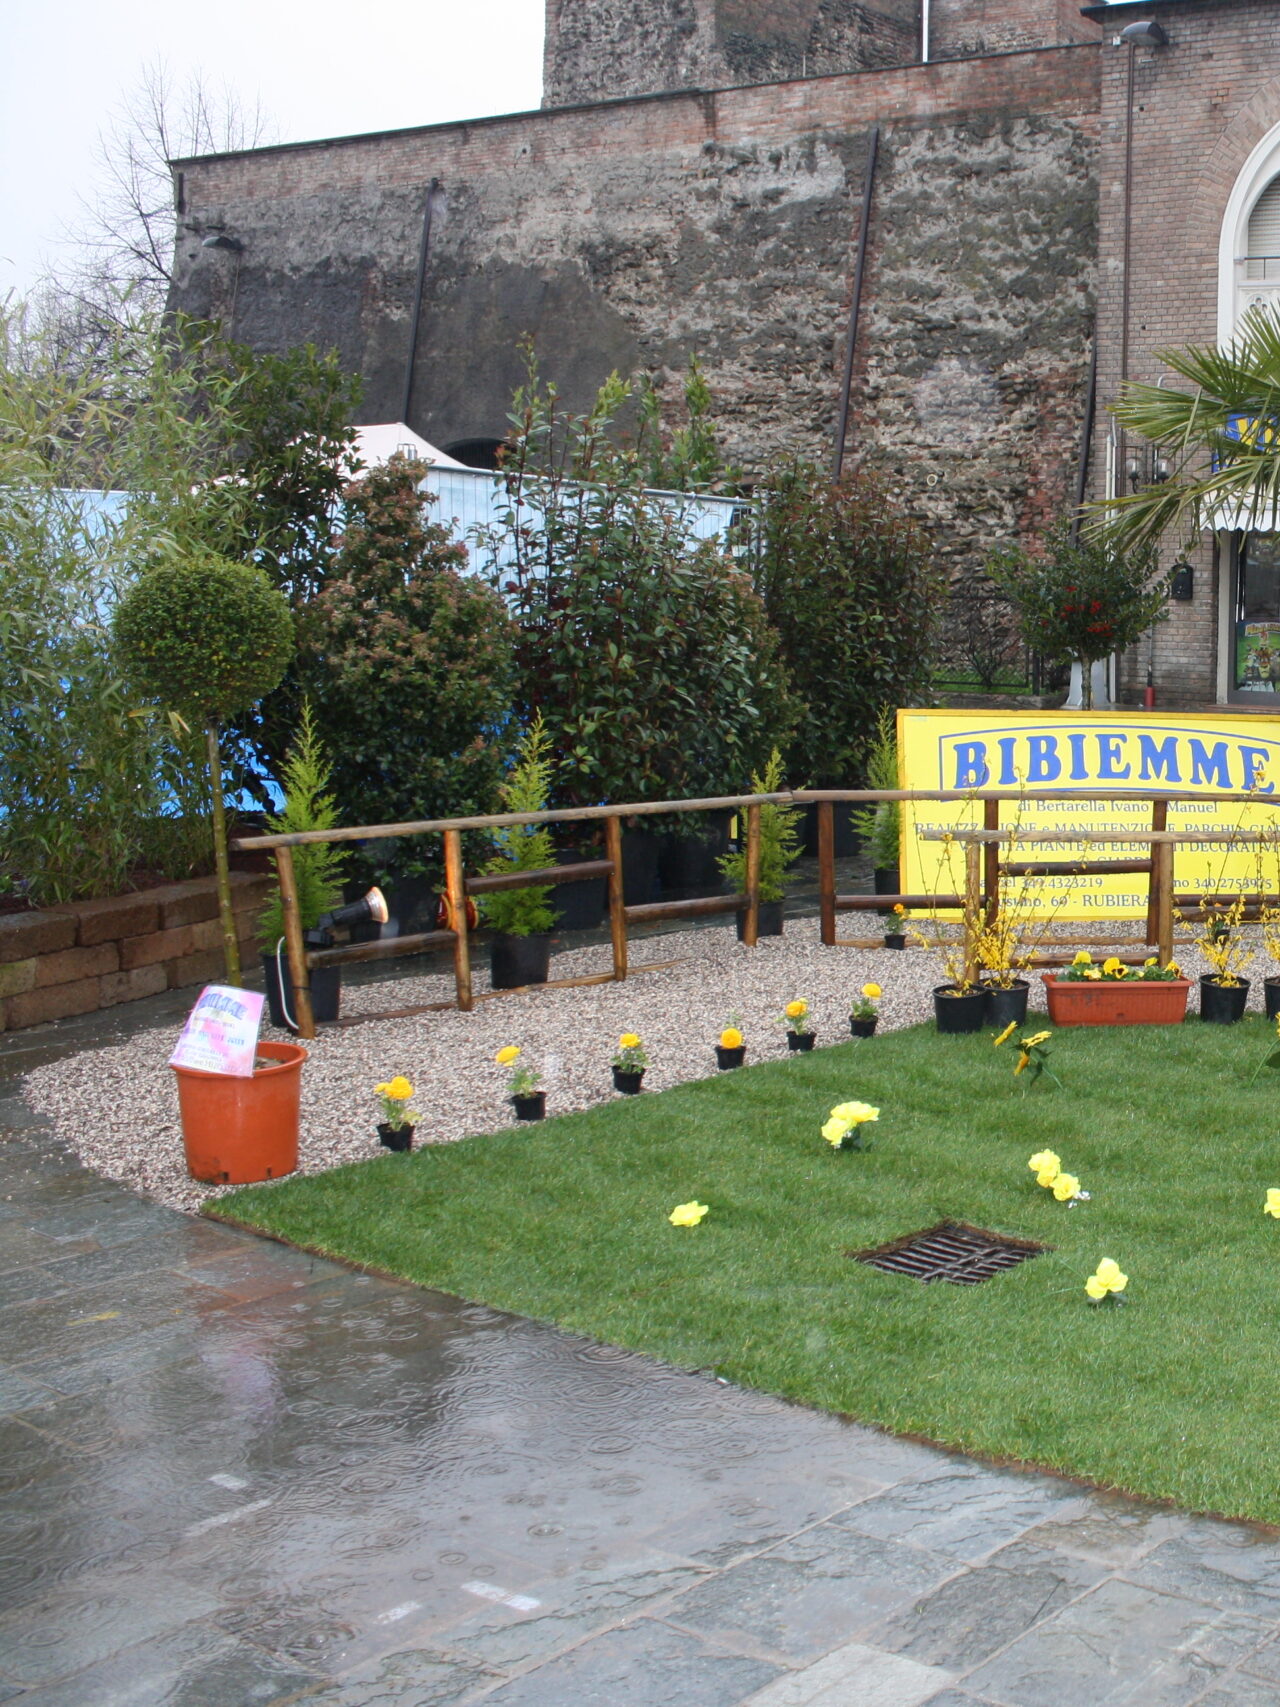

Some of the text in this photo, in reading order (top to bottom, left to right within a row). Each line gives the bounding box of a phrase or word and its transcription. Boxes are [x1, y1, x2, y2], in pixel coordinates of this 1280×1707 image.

[953, 733, 1275, 794] BIBIEMME
[1018, 800, 1218, 813] di Bertarella Ivano Manuel
[915, 822, 1038, 832] REALIZZIONE
[1054, 822, 1176, 832] MANUTENZIOE
[1089, 841, 1105, 852] ed
[1111, 841, 1185, 852] ELEMTI
[1082, 894, 1150, 907] RUBIERA
